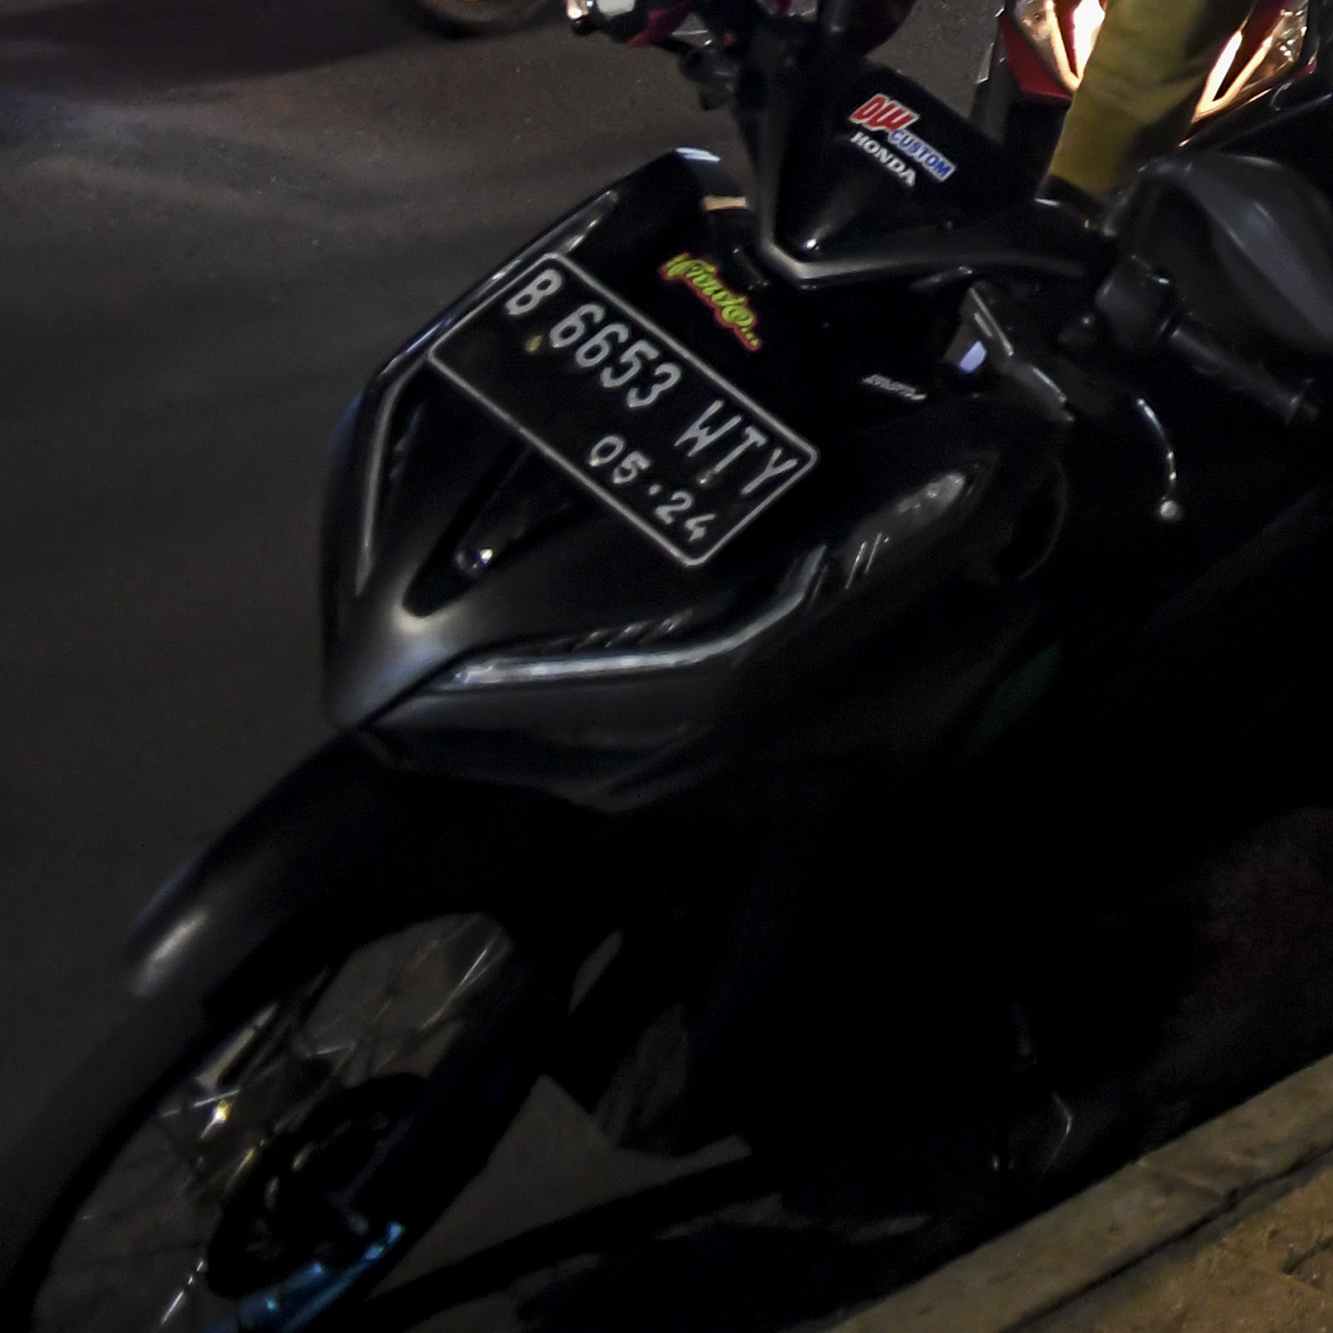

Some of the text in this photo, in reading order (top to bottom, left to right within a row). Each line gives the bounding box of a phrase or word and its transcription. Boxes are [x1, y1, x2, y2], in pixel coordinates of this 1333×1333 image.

[849, 130, 917, 187] HONDA
[888, 128, 954, 179] CUSTOM
[505, 268, 799, 496] B 6653 WTY
